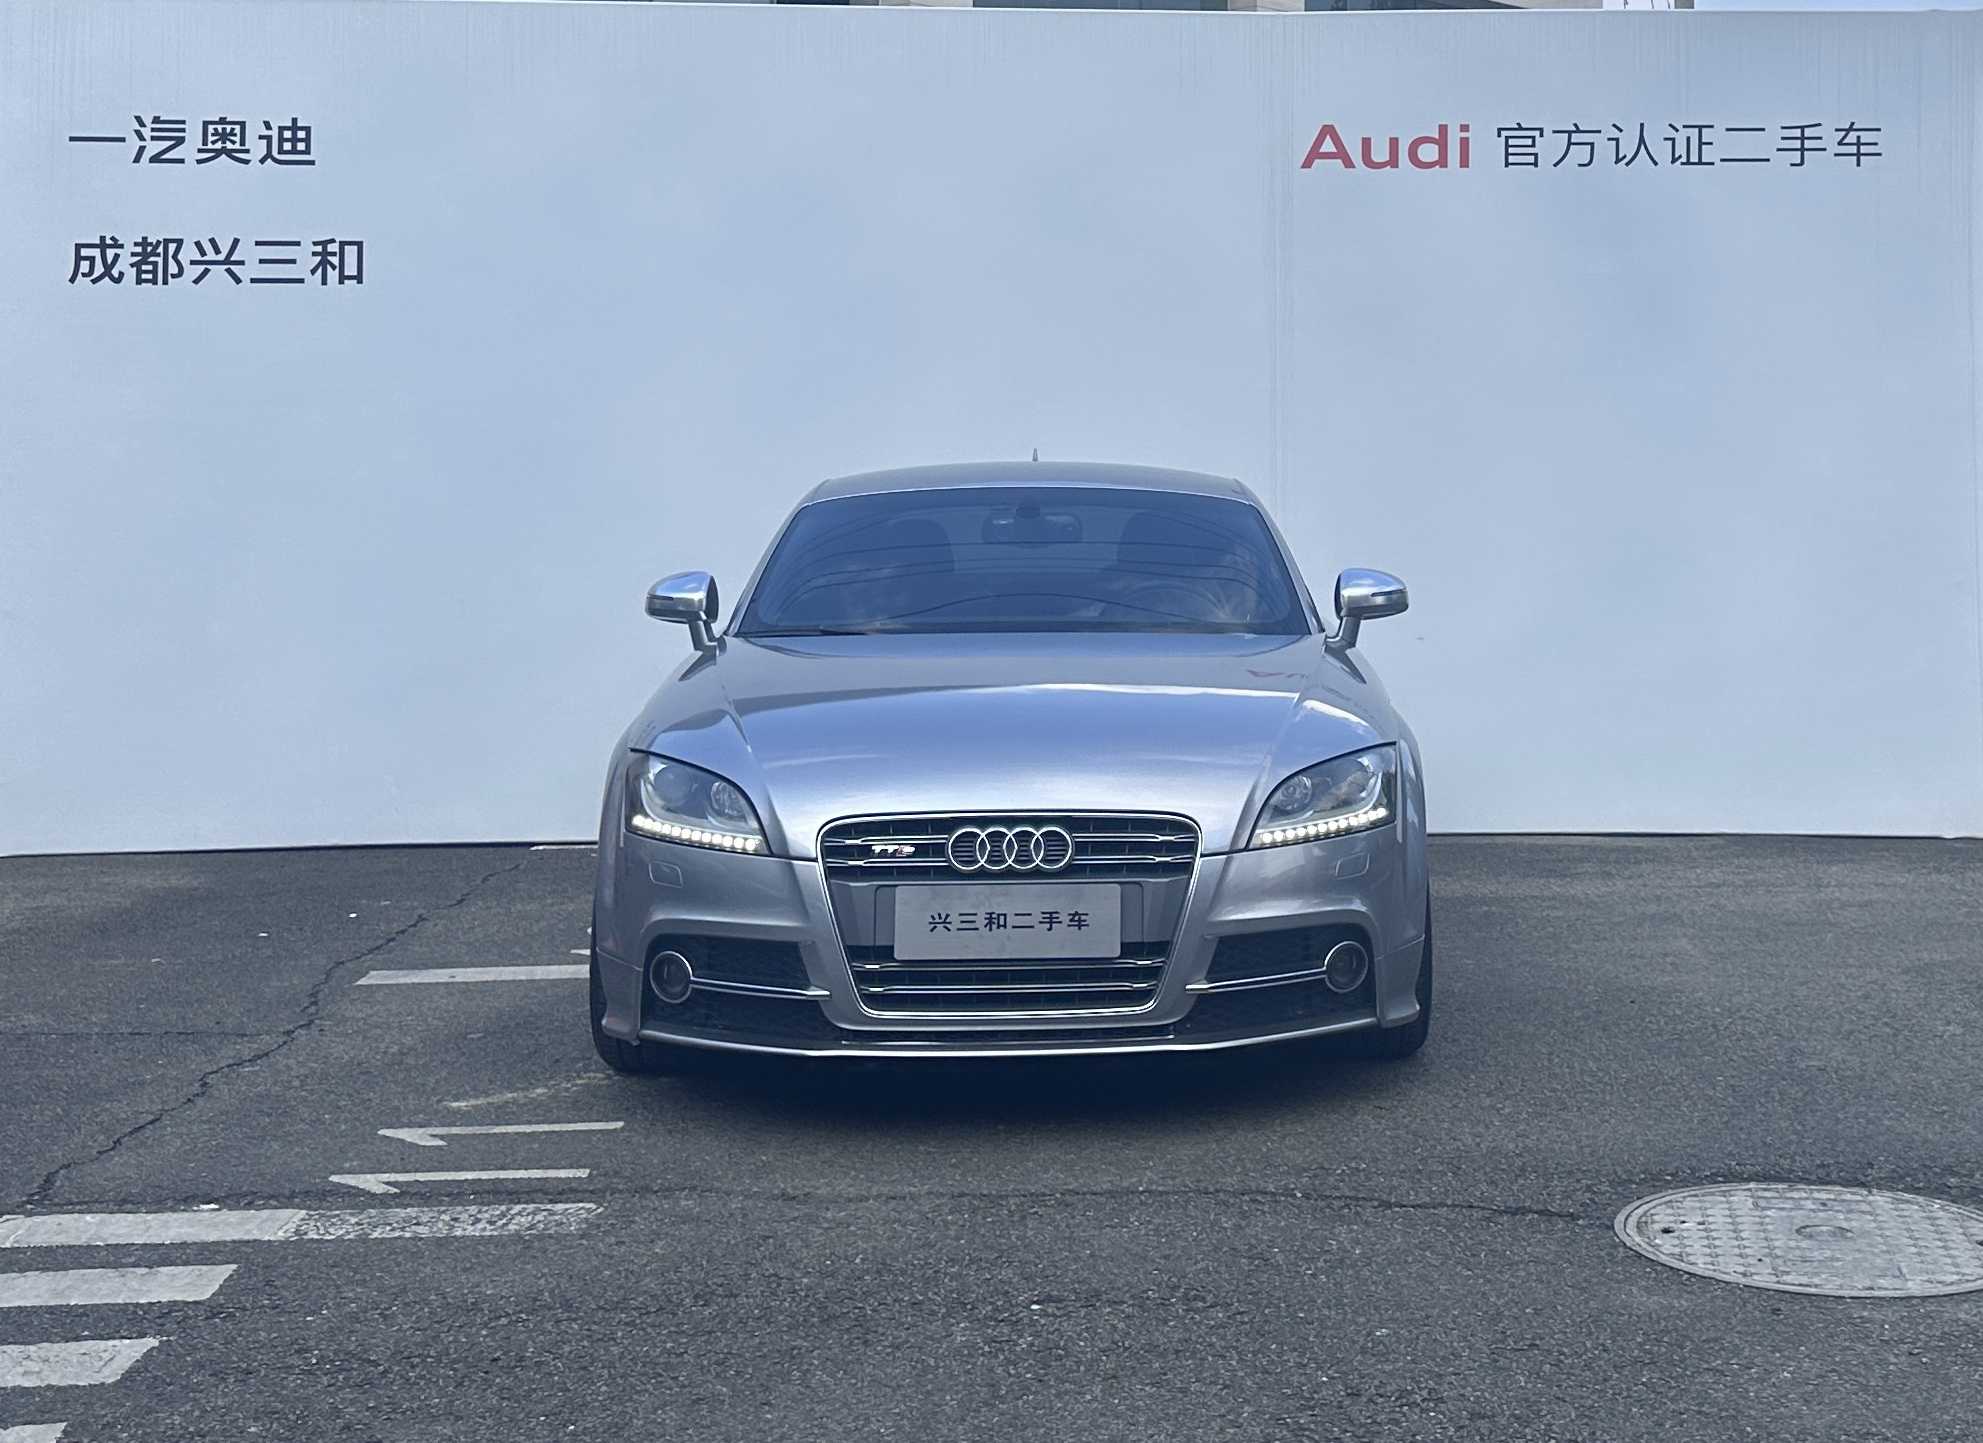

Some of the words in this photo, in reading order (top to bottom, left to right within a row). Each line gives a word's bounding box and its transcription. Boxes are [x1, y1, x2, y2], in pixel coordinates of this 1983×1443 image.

[68, 115, 316, 166] 一汽奥迪
[1300, 123, 1471, 170] Audi
[1496, 122, 1883, 168] 官方认证二手车
[68, 235, 365, 286] 成都兴三和
[928, 910, 1090, 933] 兴三和二手车
